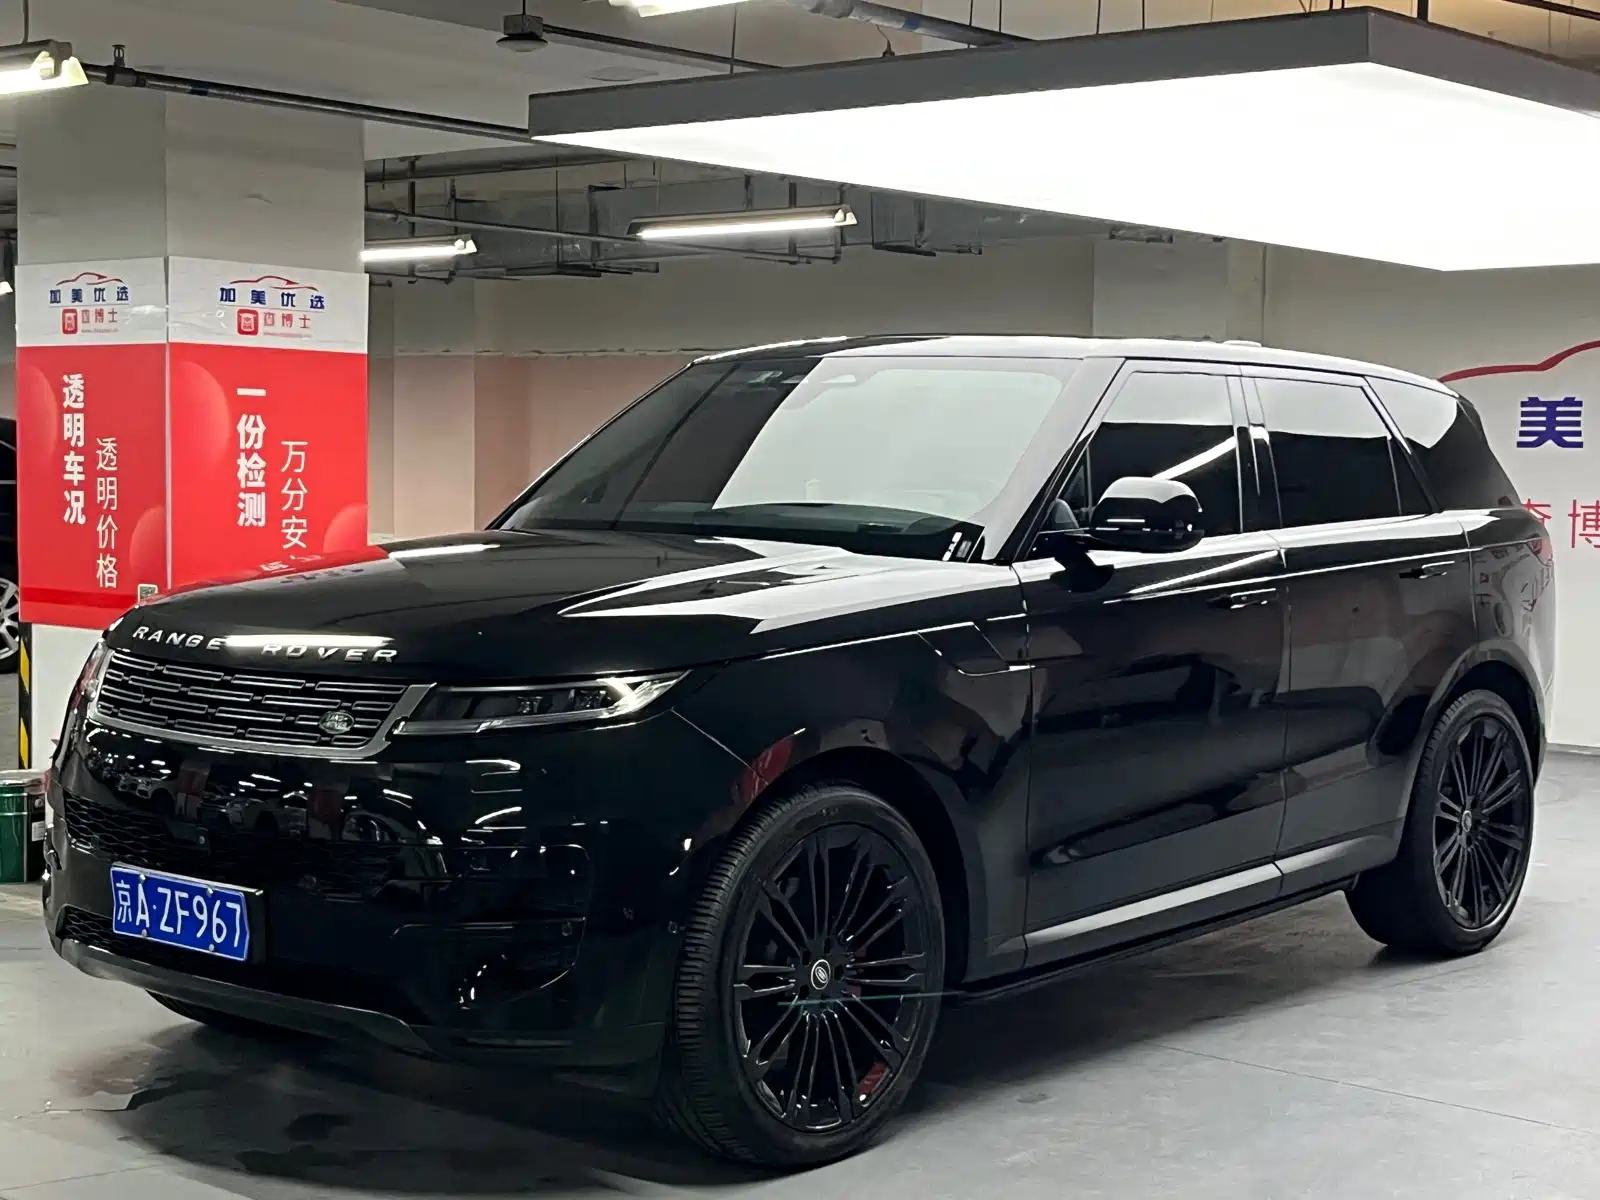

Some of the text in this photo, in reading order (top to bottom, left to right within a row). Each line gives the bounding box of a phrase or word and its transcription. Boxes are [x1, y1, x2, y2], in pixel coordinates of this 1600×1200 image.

[50, 286, 129, 304] 加美优选
[220, 287, 325, 309] 加美优选
[62, 373, 86, 525] 透明车况
[1516, 397, 1584, 448] 美
[236, 388, 266, 527] 一份检测
[96, 437, 118, 589] 透明价格
[280, 441, 308, 559] 万分安
[132, 626, 398, 663] RANGE ROVER
[116, 880, 241, 948] 京A·ZF967
